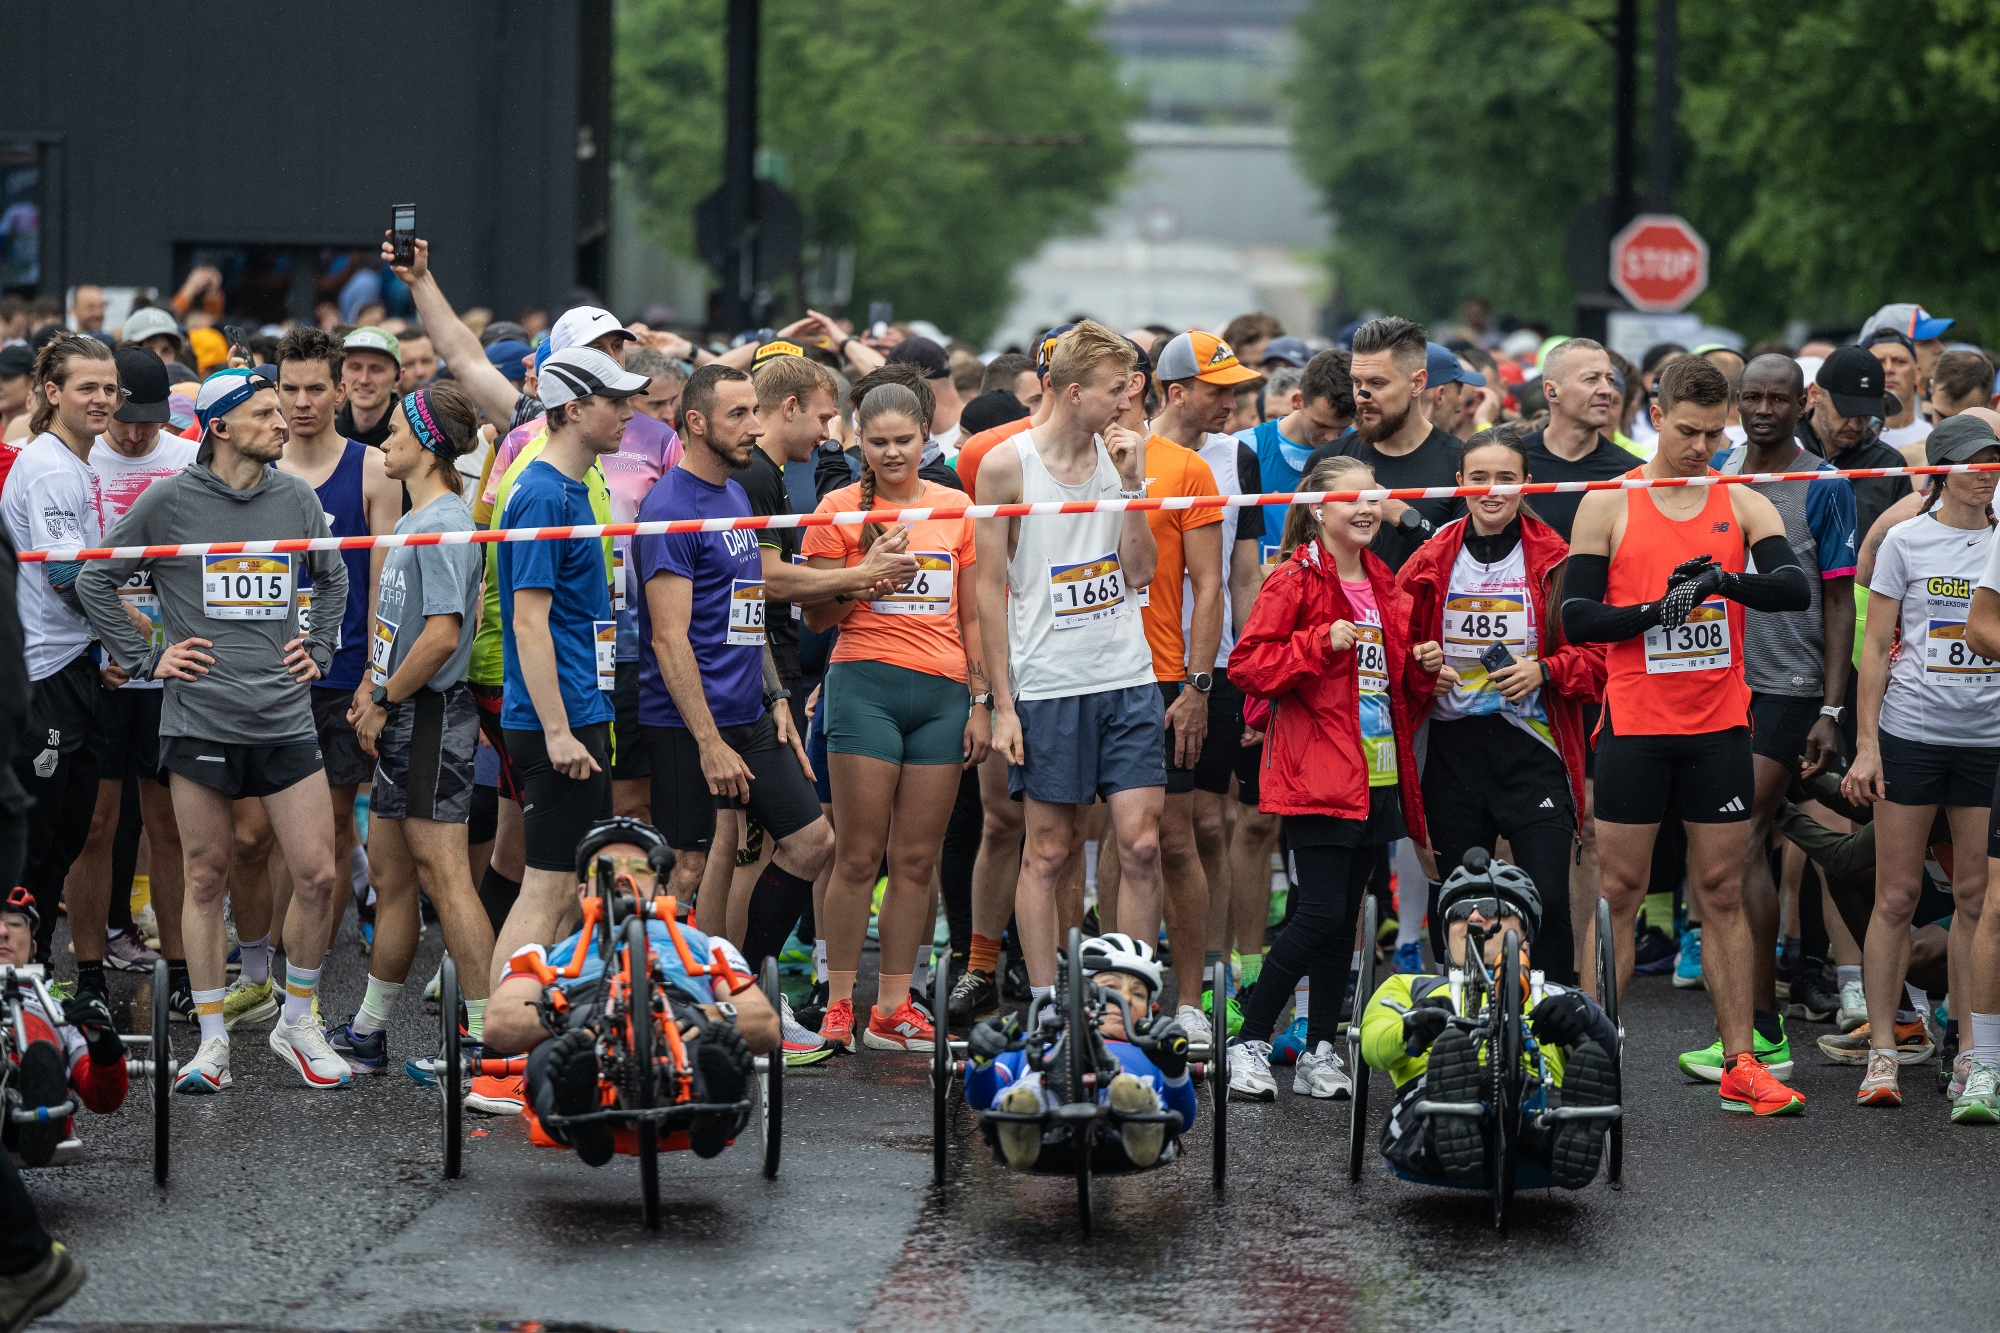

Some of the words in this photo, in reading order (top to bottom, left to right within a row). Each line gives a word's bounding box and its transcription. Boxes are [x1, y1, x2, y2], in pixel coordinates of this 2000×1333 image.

[1624, 246, 1693, 280] STOP
[404, 392, 430, 445] ERTICA
[612, 462, 640, 472] ADAM
[220, 575, 282, 600] 1015
[1066, 574, 1119, 607] 1663
[1926, 576, 1971, 600] Gold
[1483, 600, 1492, 608] 32
[1927, 598, 1969, 609] KOMPLEKSOWE
[1460, 614, 1508, 638] 485
[1661, 623, 1723, 651] 1308
